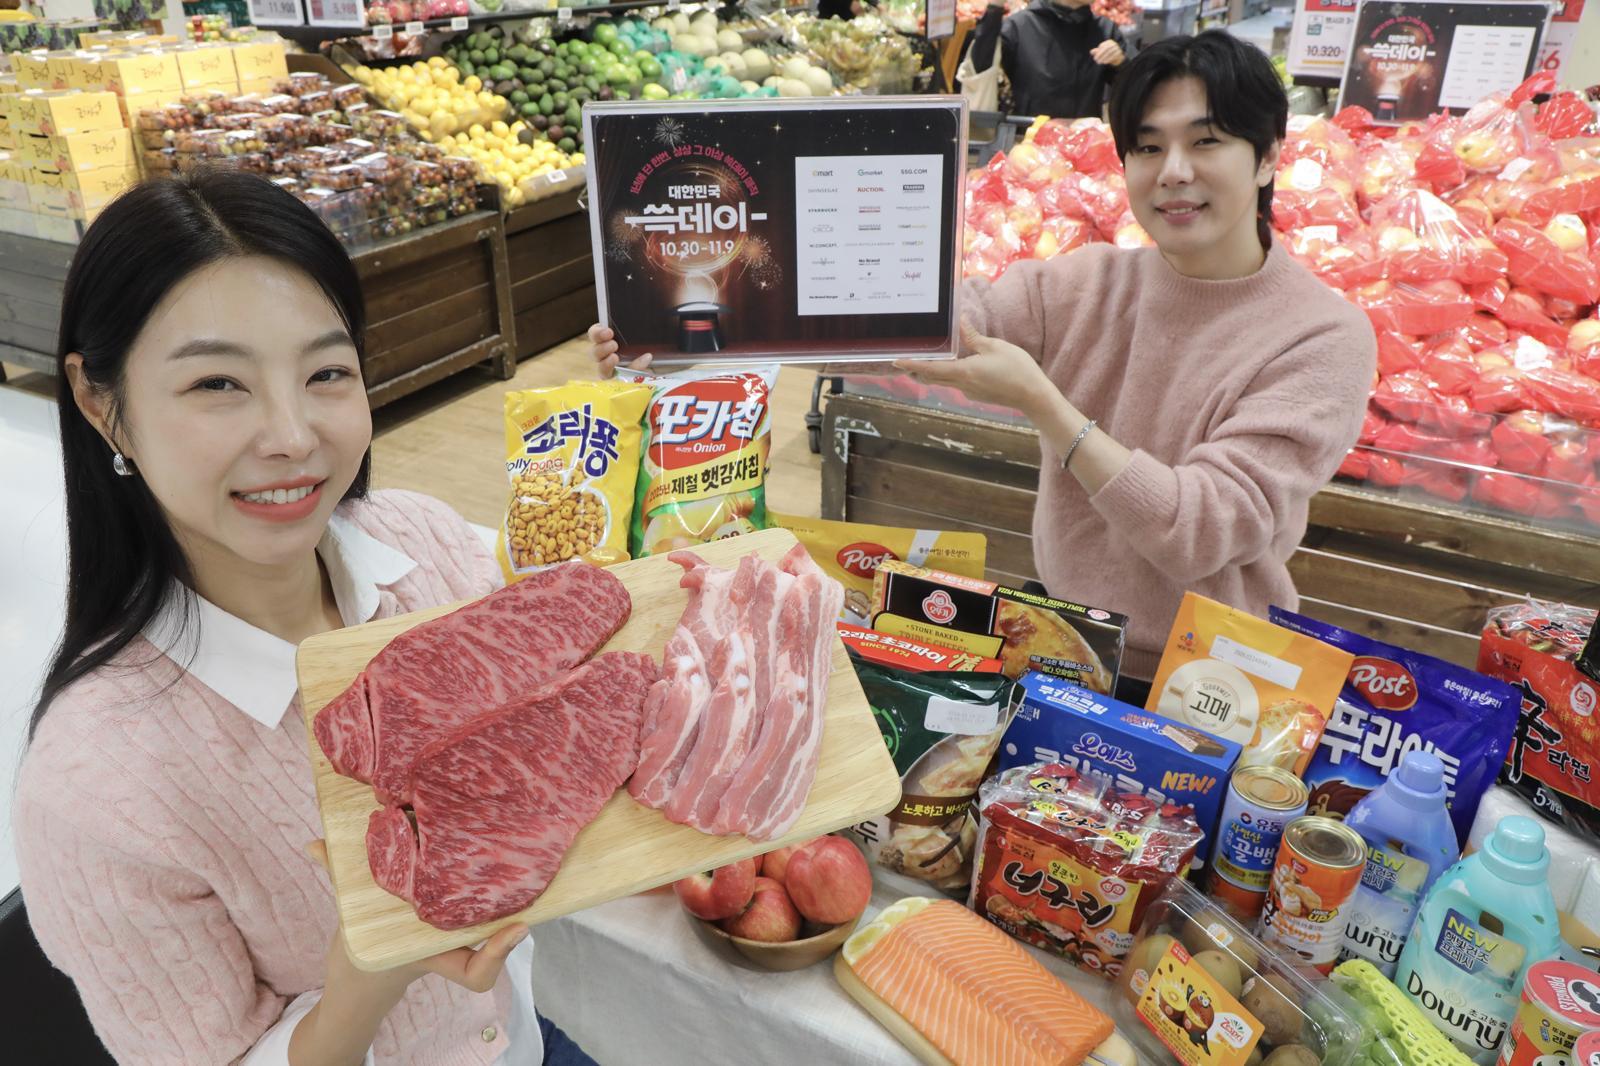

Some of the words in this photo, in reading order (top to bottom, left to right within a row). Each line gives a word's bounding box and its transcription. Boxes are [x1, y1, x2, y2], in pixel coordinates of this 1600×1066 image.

[1363, 43, 1427, 61] 쓱데이
[673, 145, 692, 158] 상상
[693, 144, 704, 155] 그
[705, 147, 725, 161] 이상
[668, 184, 721, 199] 대한민국
[624, 202, 748, 235] 쓱데이
[652, 395, 765, 443] 포카칩
[523, 403, 619, 477] 죠리퐁
[693, 442, 726, 453] Onion
[671, 474, 698, 494] 제철
[701, 453, 760, 492] 햇감자칩
[842, 549, 893, 570] Post
[910, 624, 933, 635] STONE
[935, 631, 959, 642] BAKED
[860, 641, 887, 651] SINCE
[888, 645, 911, 658] 1974
[879, 636, 948, 664] 초코파이
[1351, 664, 1410, 697] Post
[1190, 691, 1232, 722] 고메
[1073, 733, 1137, 772] 오예스
[1548, 749, 1591, 783] 라면
[1161, 770, 1217, 794] NEW!
[902, 803, 944, 817] 노릇하고
[1533, 786, 1564, 816] 5개입
[1256, 818, 1282, 833] 유동
[1232, 837, 1277, 865] 골뱅
[1051, 861, 1080, 884] 얼큰한
[1002, 860, 1116, 929] 너구리
[1345, 922, 1406, 964] wny
[1444, 930, 1489, 964] 햇빛건조
[1447, 916, 1499, 953] NEW
[1439, 939, 1474, 971] 프레시
[1543, 974, 1582, 1013] PRINGLES
[1407, 969, 1505, 1051] Downy
